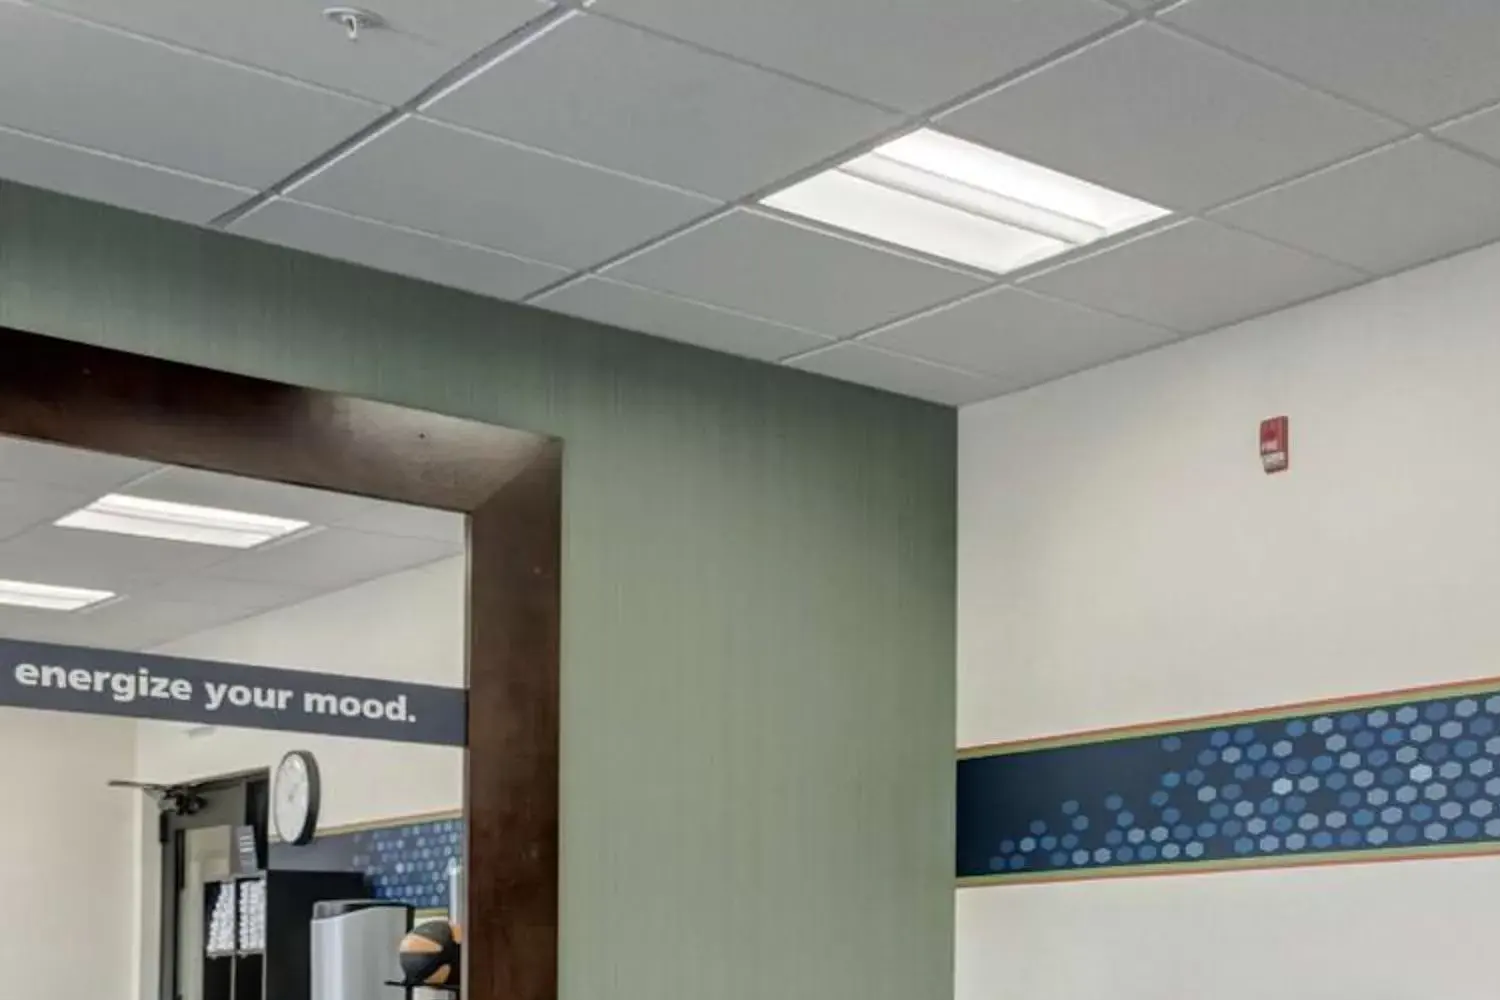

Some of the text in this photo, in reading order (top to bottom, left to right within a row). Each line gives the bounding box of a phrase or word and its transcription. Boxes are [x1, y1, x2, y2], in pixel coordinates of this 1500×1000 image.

[14, 660, 417, 723] energize your mood.
